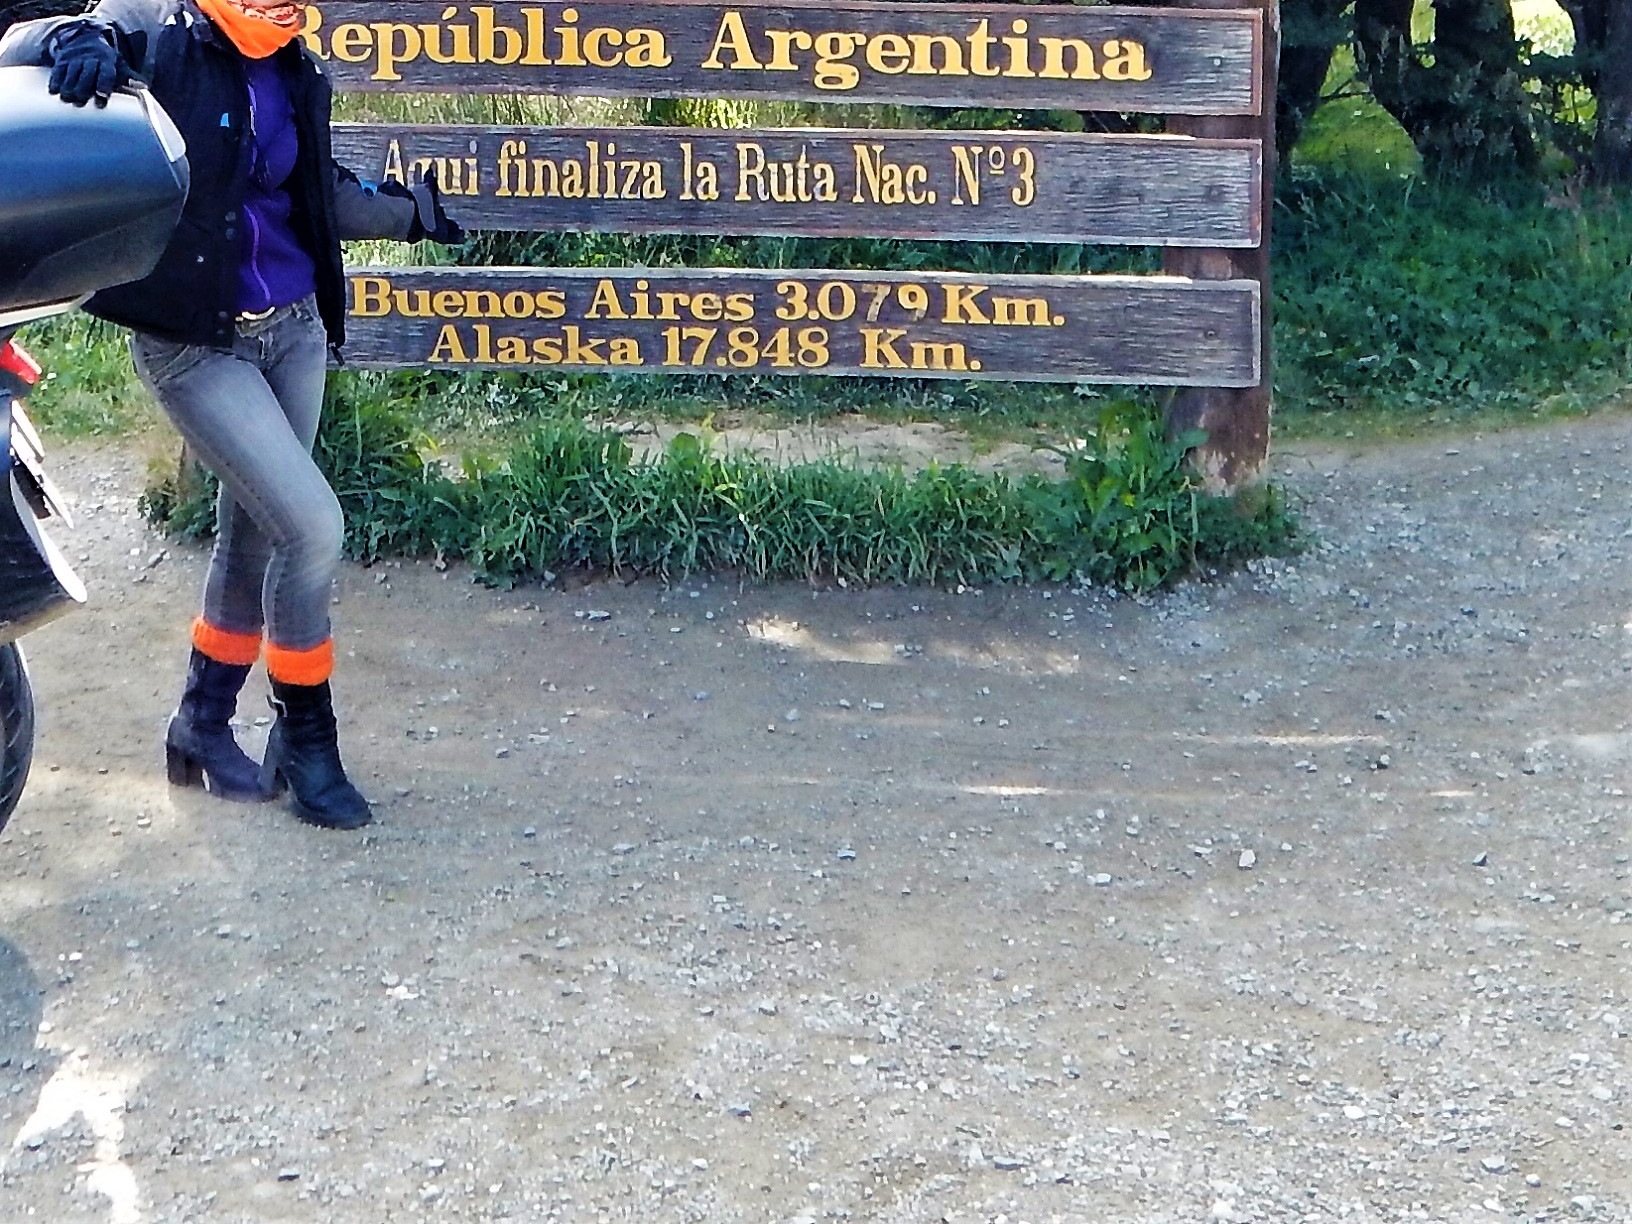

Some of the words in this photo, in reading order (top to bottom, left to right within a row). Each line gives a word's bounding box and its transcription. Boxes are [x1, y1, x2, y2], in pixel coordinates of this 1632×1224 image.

[701, 10, 1152, 90] Argentina
[495, 140, 667, 199] finaliza
[679, 142, 719, 201] la
[734, 142, 838, 202] Ruta
[852, 144, 936, 205] Nac.
[348, 277, 566, 319] Buenos
[584, 279, 754, 321] Aires
[775, 280, 929, 321] 3.079
[941, 283, 1065, 326] Km.
[427, 324, 644, 365] Alaska
[661, 326, 830, 368] 17.848
[859, 327, 981, 371] Km.
